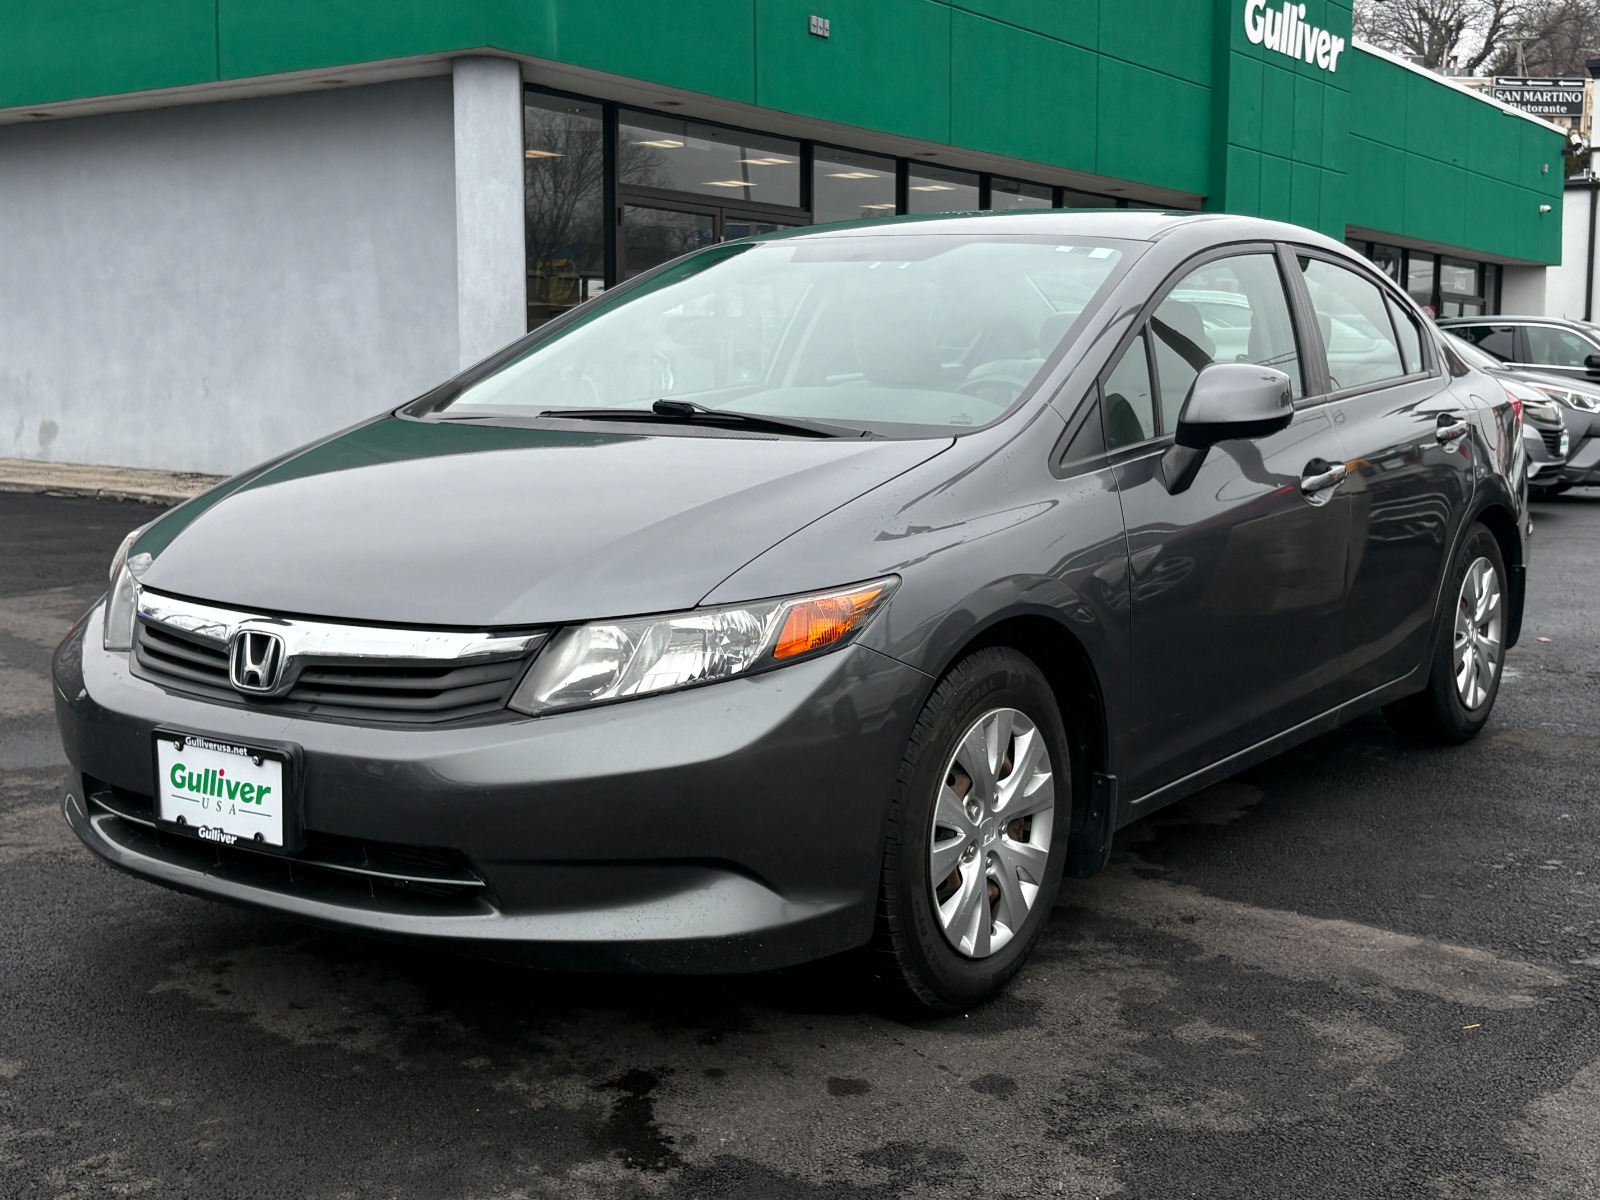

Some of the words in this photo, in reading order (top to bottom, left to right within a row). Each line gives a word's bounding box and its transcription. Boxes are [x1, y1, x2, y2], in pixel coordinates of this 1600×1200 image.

[1244, 0, 1345, 73] Gulliver
[1496, 91, 1520, 102] SAN
[1523, 92, 1581, 103] MARTINO
[185, 736, 248, 756] Gulliverusa.net
[170, 763, 272, 805] Gulliver
[198, 827, 238, 845] Gulliver
